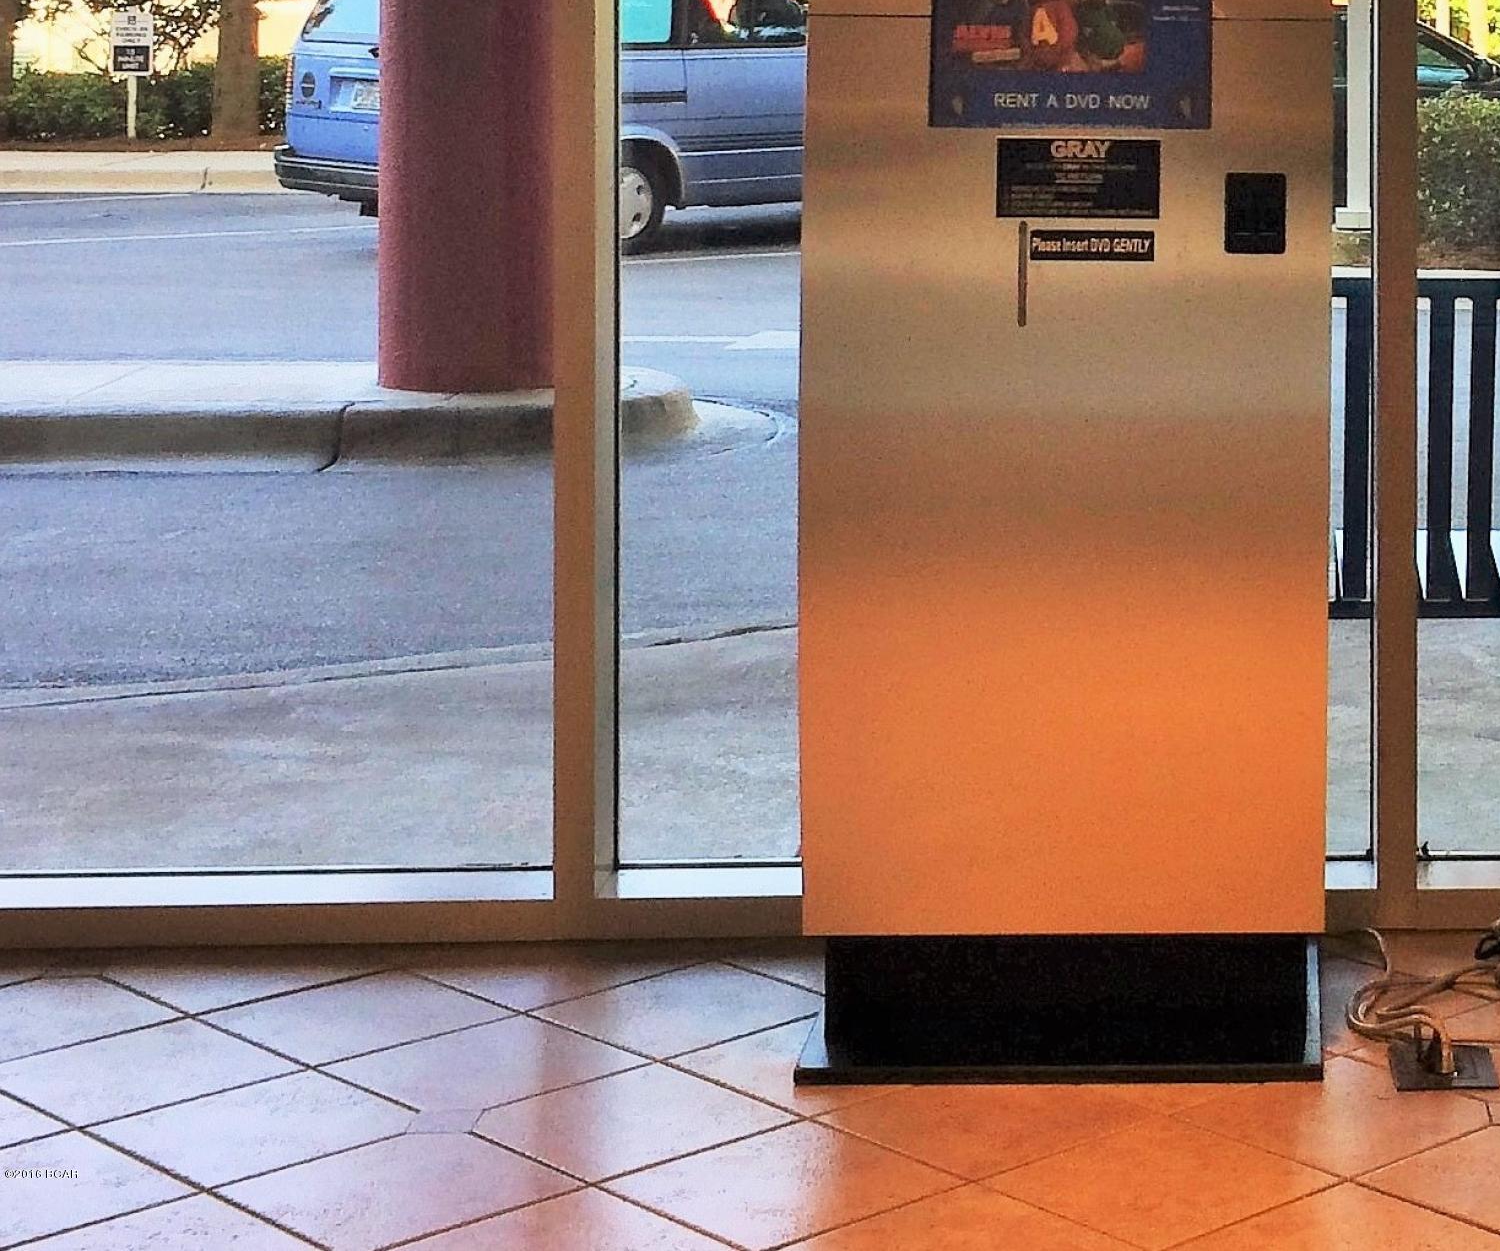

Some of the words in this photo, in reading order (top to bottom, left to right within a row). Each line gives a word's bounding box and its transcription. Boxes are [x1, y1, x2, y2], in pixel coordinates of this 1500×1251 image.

[994, 93, 1039, 108] RENT
[1046, 93, 1058, 108] A
[1065, 93, 1100, 109] DVD
[1109, 94, 1150, 110] NOW
[1050, 140, 1111, 159] GRAY
[1032, 237, 1061, 252] Please
[1090, 238, 1111, 252] DVD
[1113, 238, 1151, 253] GENTLY
